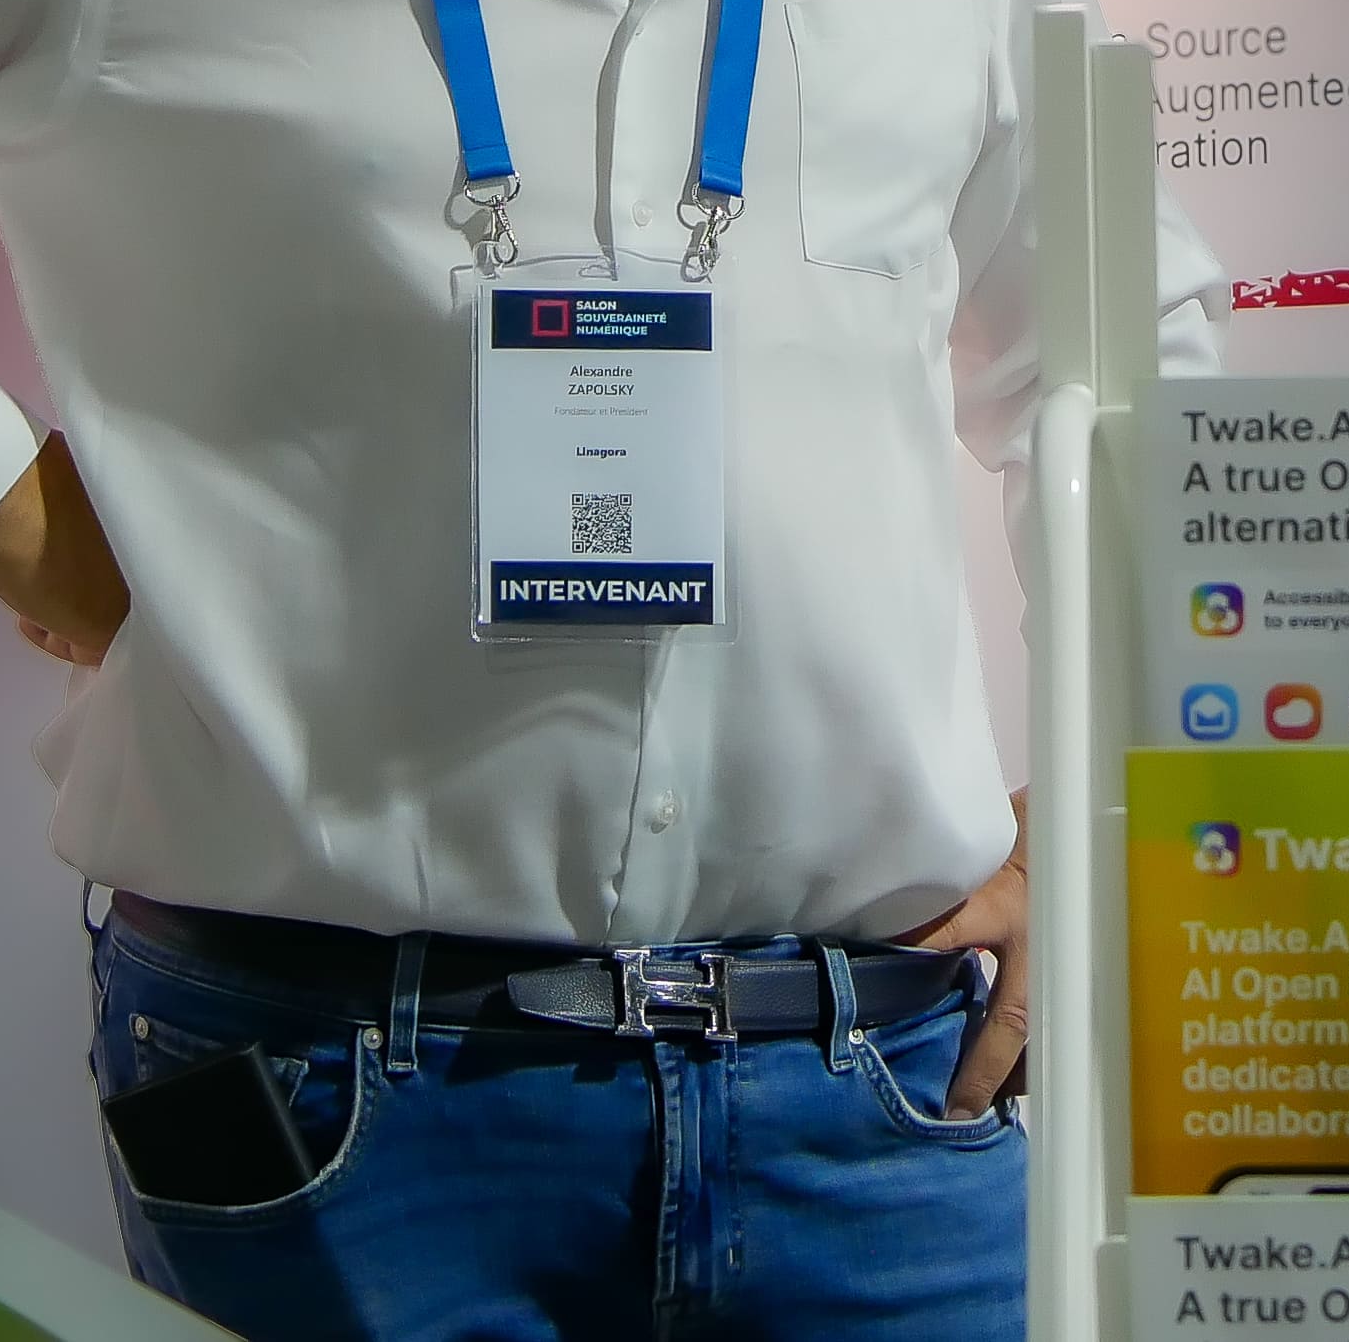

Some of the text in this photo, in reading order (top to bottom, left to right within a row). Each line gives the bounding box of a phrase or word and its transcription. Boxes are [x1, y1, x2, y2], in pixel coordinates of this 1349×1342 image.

[1147, 22, 1286, 59] Source
[1155, 129, 1268, 168] ration
[575, 300, 617, 310] SALON
[575, 311, 667, 324] SOUVERAINETÉ
[575, 323, 648, 336] NUMÉRIQUE
[569, 365, 633, 378] Alexandre
[568, 384, 635, 396] ZAPOLSKY
[575, 446, 627, 459] Linagora
[1183, 462, 1210, 493] A
[1224, 462, 1306, 493] true
[499, 579, 707, 604] INTERVENANT
[1264, 614, 1283, 629] to
[1180, 966, 1221, 1001] AI
[1232, 966, 1340, 1008] Open
[1181, 1010, 1349, 1055] platform
[1176, 1290, 1205, 1324] A
[1220, 1291, 1307, 1324] true
